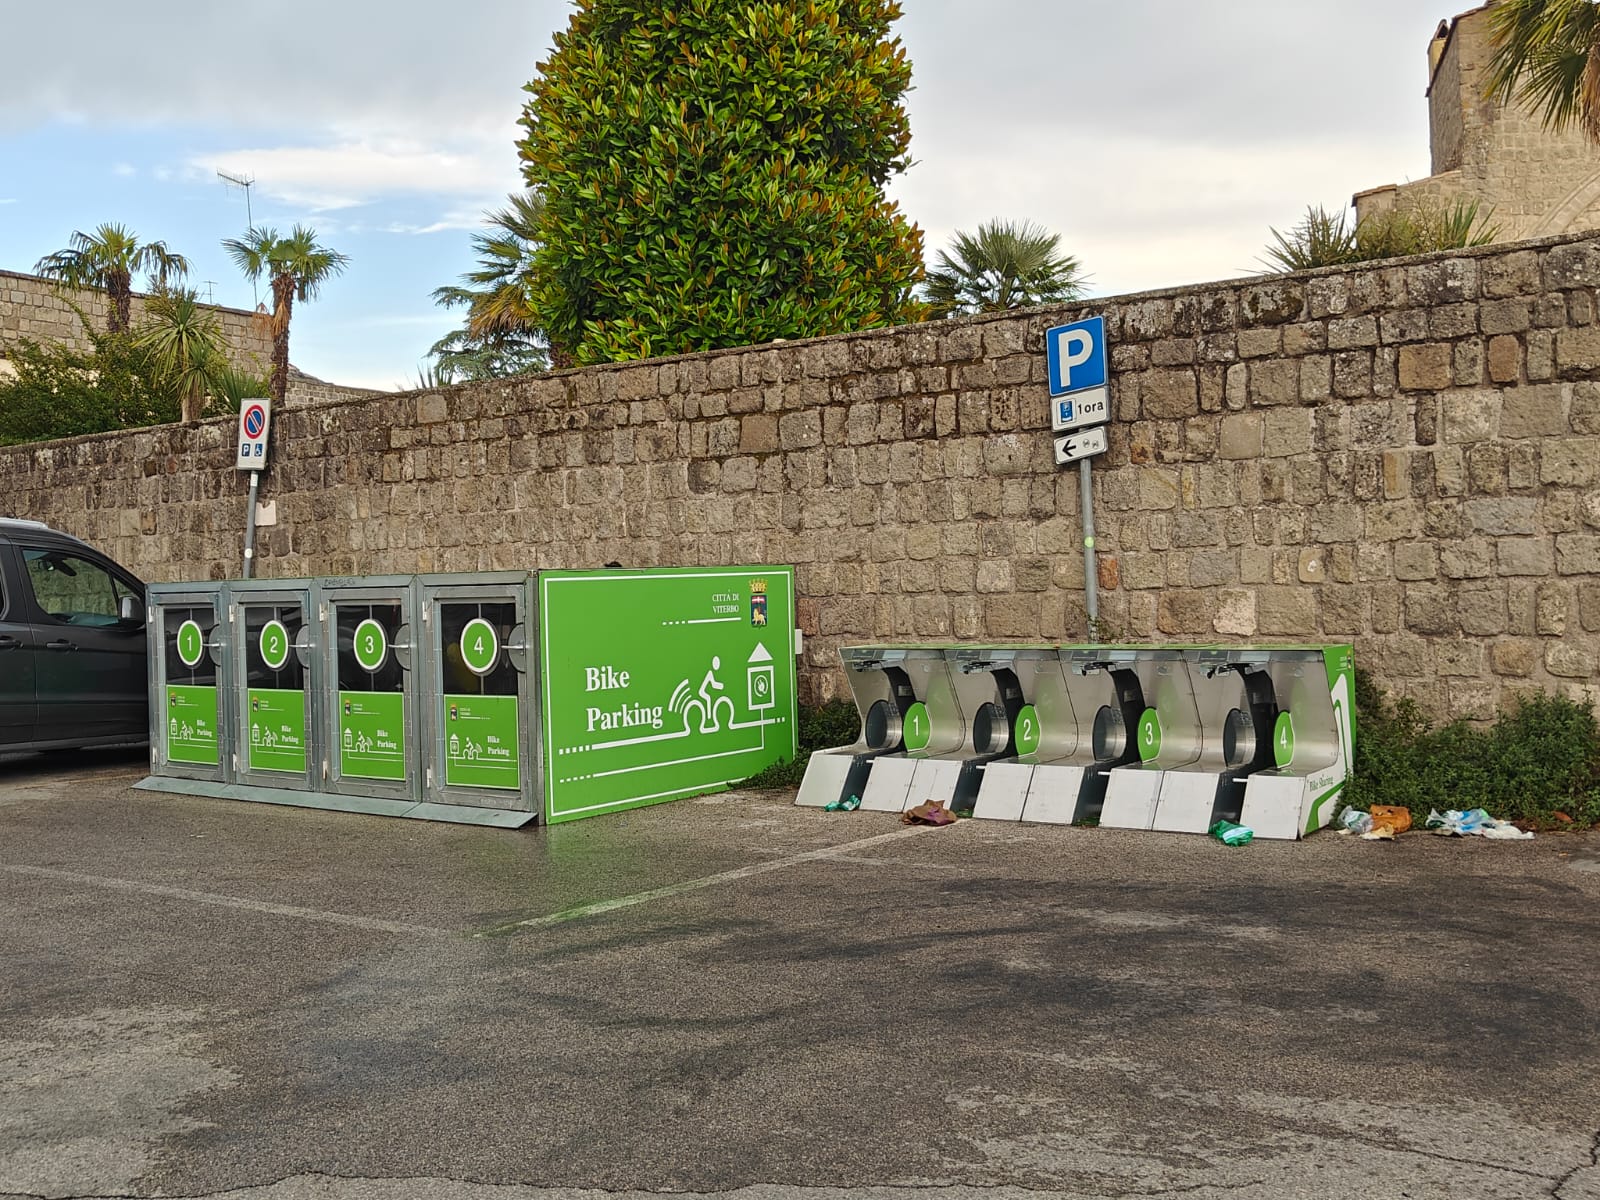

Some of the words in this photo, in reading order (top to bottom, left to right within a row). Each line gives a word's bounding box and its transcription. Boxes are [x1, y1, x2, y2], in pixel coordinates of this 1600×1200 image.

[1058, 328, 1094, 388] P
[243, 445, 249, 455] P
[712, 604, 739, 614] VITERBO
[186, 636, 193, 652] 1
[269, 636, 278, 654] 2
[365, 636, 374, 654] 3
[474, 636, 484, 655] 4
[585, 665, 630, 692] Bike
[196, 719, 205, 727] Bike
[586, 702, 664, 732] Parking
[196, 729, 212, 738] Parking
[281, 725, 292, 733] Bike
[376, 729, 389, 738] Bike
[912, 719, 919, 737] 1
[1022, 719, 1032, 741] 2
[1144, 721, 1155, 745] 3
[281, 735, 299, 744] Parking
[377, 740, 397, 750] Parking
[487, 735, 500, 744] Bike
[1279, 725, 1288, 749] 4
[487, 747, 510, 757] Parking
